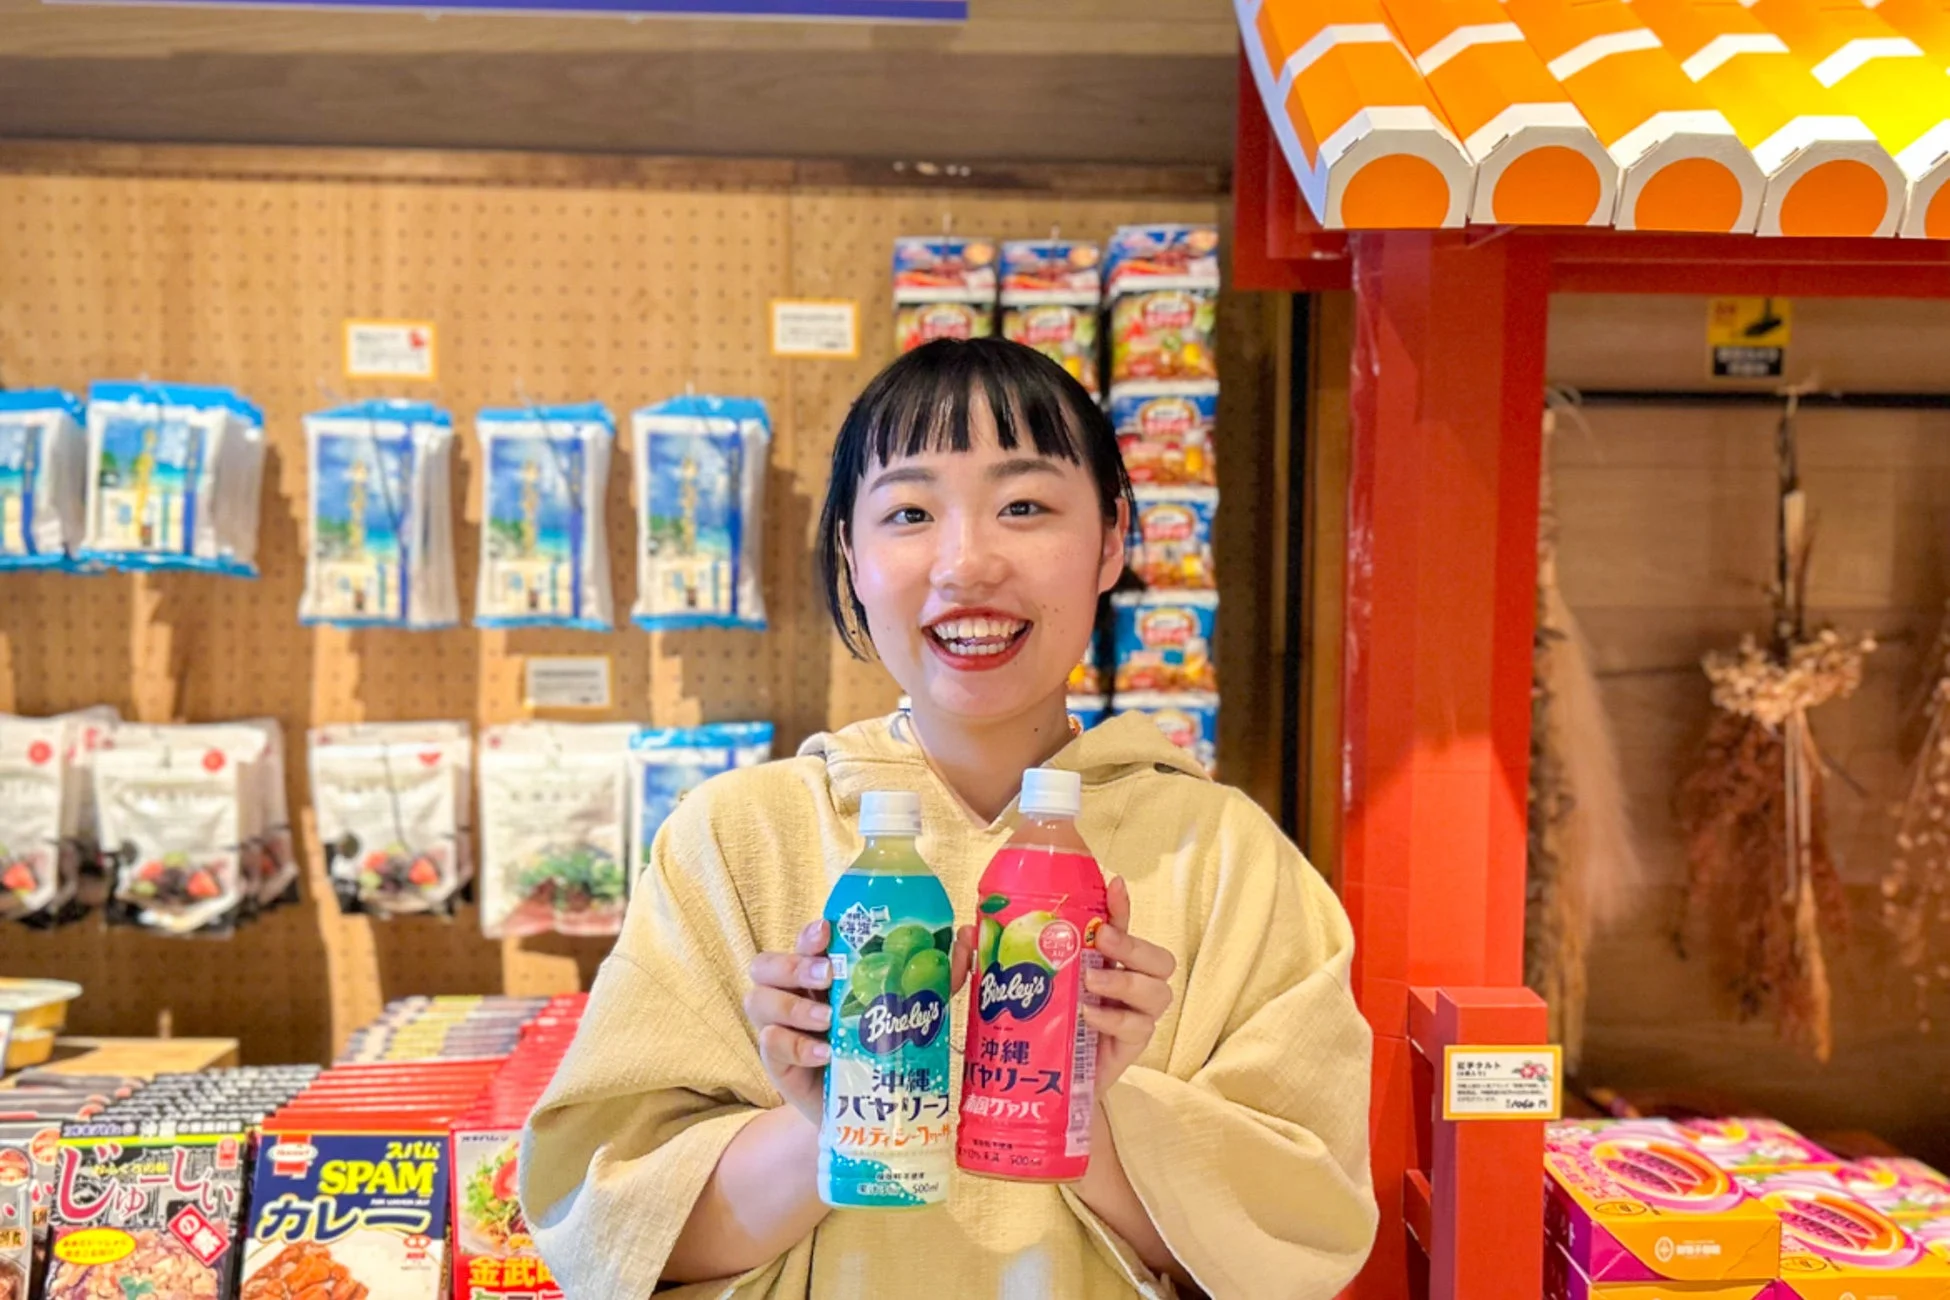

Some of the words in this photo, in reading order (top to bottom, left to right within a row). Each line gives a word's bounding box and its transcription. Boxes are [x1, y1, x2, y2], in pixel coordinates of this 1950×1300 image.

[981, 972, 1045, 1011] Bireley's
[865, 1001, 939, 1042] Bireley's
[981, 1037, 1029, 1065] 沖縄
[872, 1068, 930, 1093] 沖縄
[385, 1141, 440, 1160] スパム
[318, 1159, 435, 1196] SPAM
[254, 1193, 432, 1244] カレー
